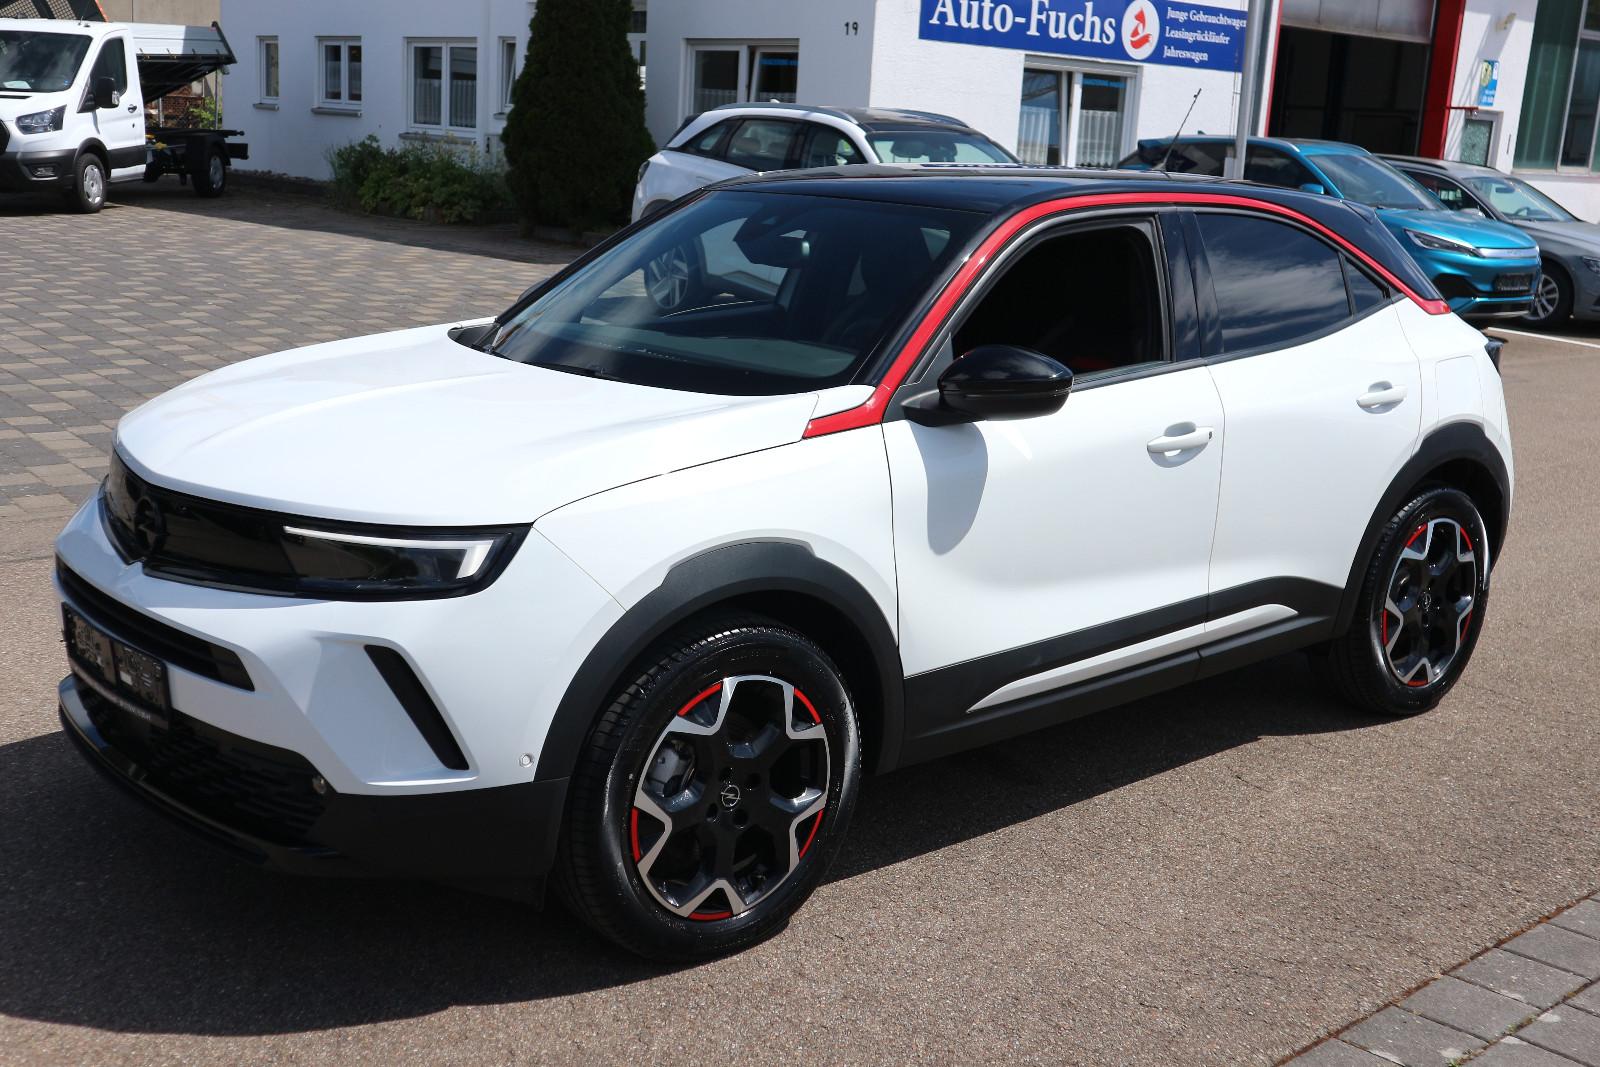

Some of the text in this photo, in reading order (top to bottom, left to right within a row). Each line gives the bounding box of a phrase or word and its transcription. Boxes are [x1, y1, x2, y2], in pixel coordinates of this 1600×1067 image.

[929, 0, 1116, 45] Auto-Fuchs
[1167, 6, 1188, 22] Junge
[844, 21, 859, 36] 19
[1165, 26, 1230, 44] Leasingrückläufer
[1163, 45, 1208, 63] Jahreswagen
